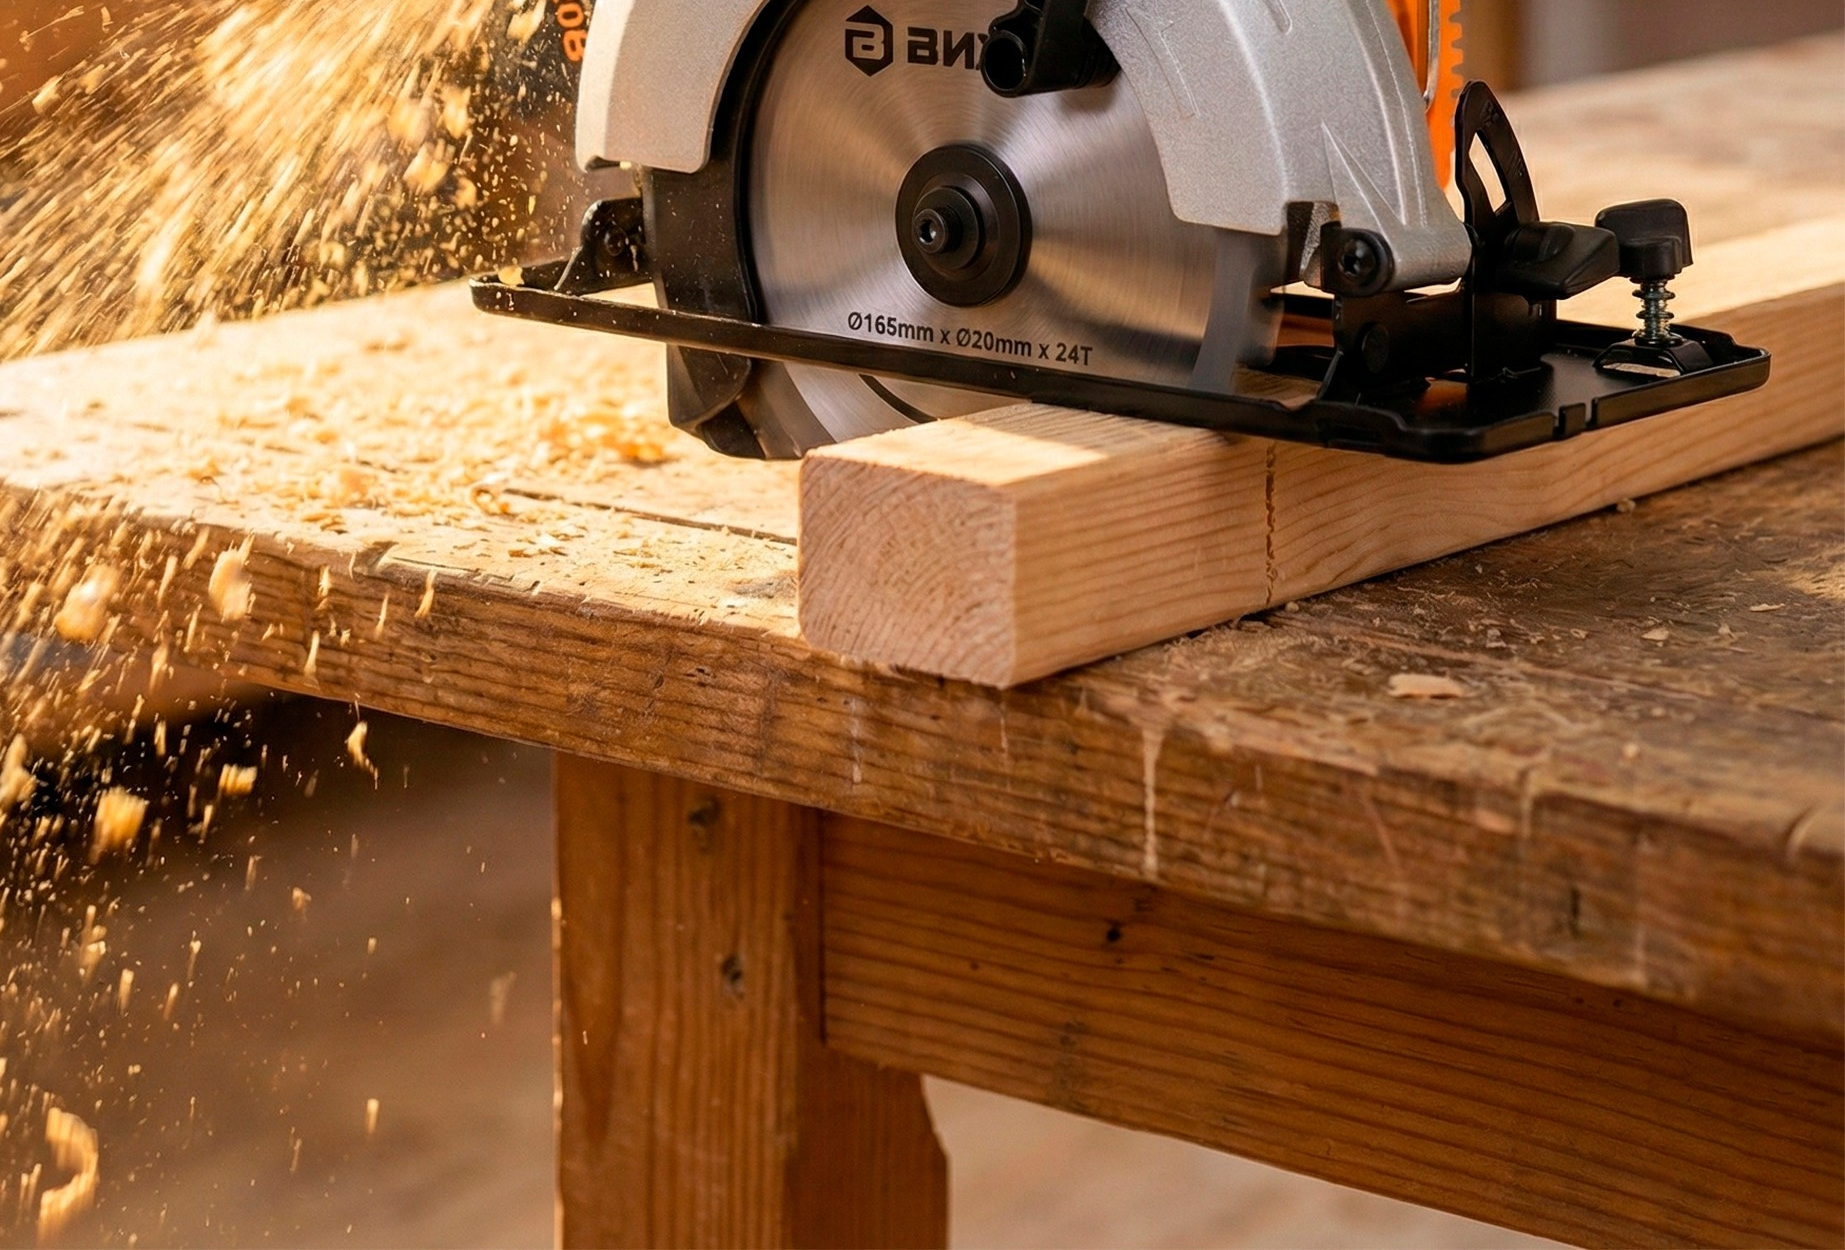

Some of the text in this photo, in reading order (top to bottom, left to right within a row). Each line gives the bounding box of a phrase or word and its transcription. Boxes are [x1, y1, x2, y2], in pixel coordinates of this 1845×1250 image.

[907, 26, 987, 71] ВИ
[848, 311, 934, 342] Ø165mm
[957, 327, 1032, 357] Ø20mm
[1056, 342, 1093, 366] 24T
